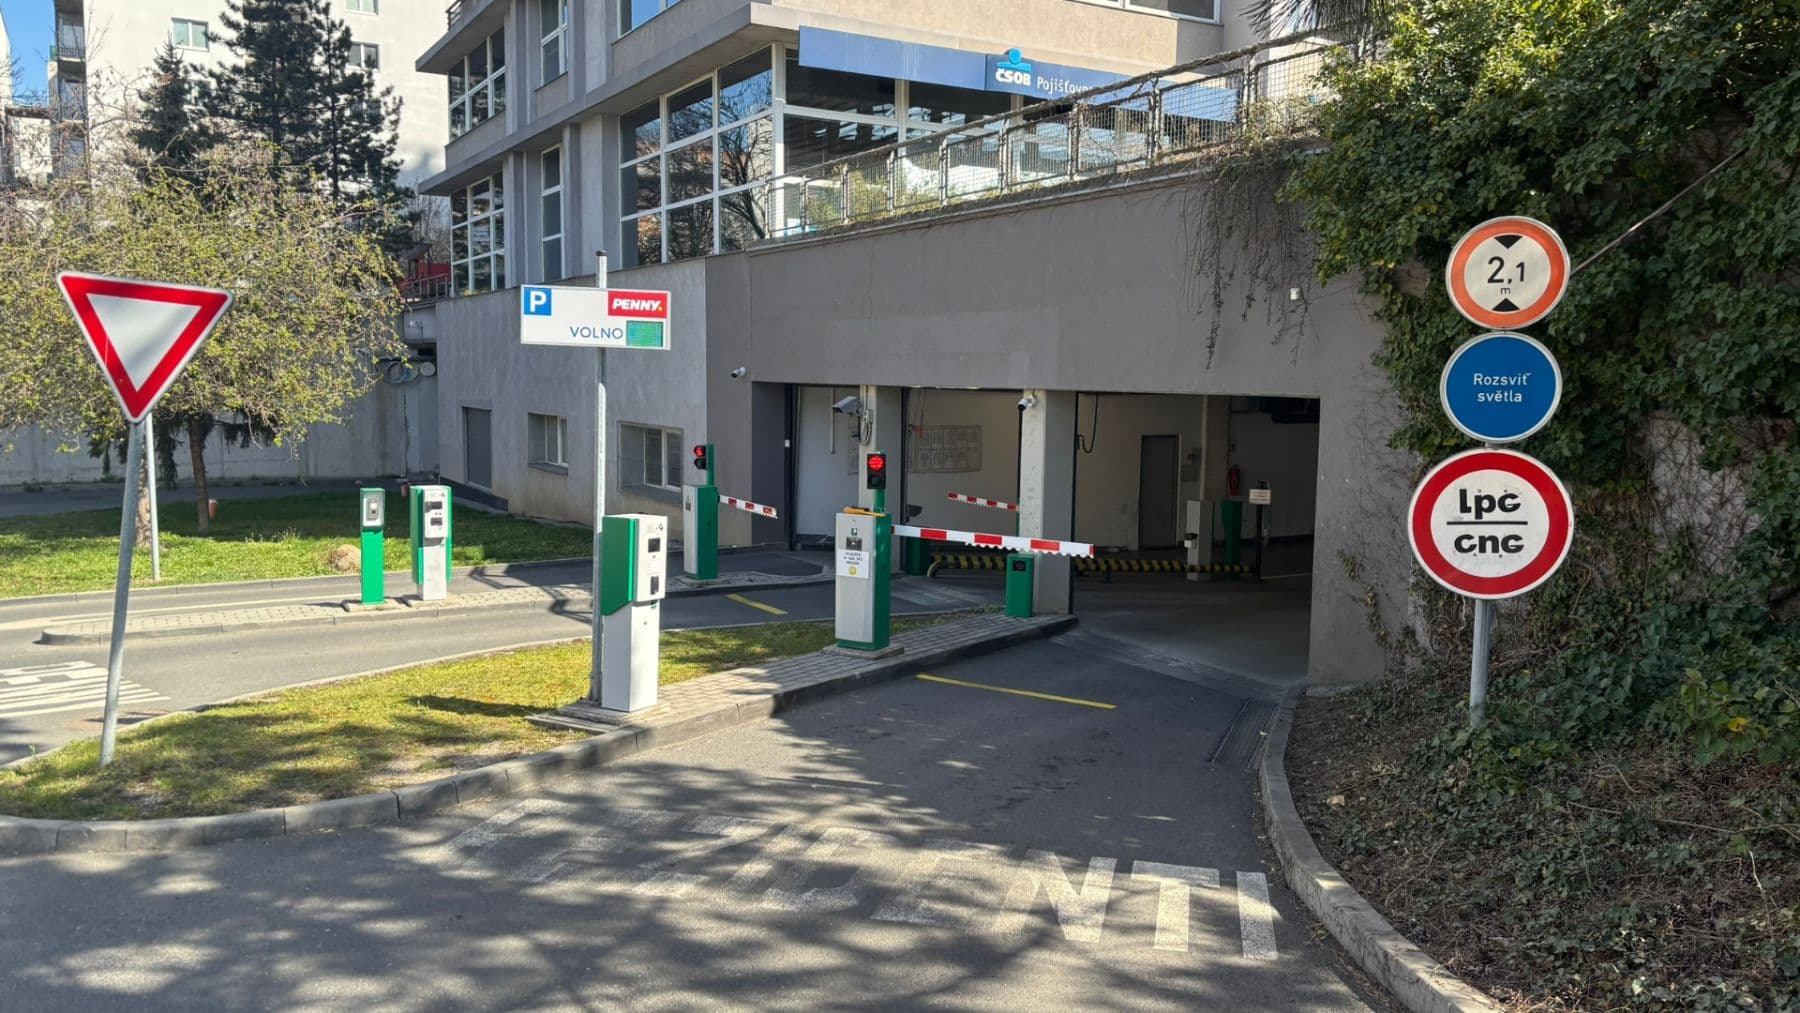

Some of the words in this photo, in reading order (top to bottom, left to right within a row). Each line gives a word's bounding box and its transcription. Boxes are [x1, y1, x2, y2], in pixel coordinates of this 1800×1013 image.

[995, 68, 1032, 86] ČSOB
[1487, 256, 1525, 285] 2,1
[529, 290, 547, 313] P
[570, 326, 624, 339] VOLNO
[1473, 372, 1531, 386] Rozsviť
[1477, 391, 1522, 403] světla
